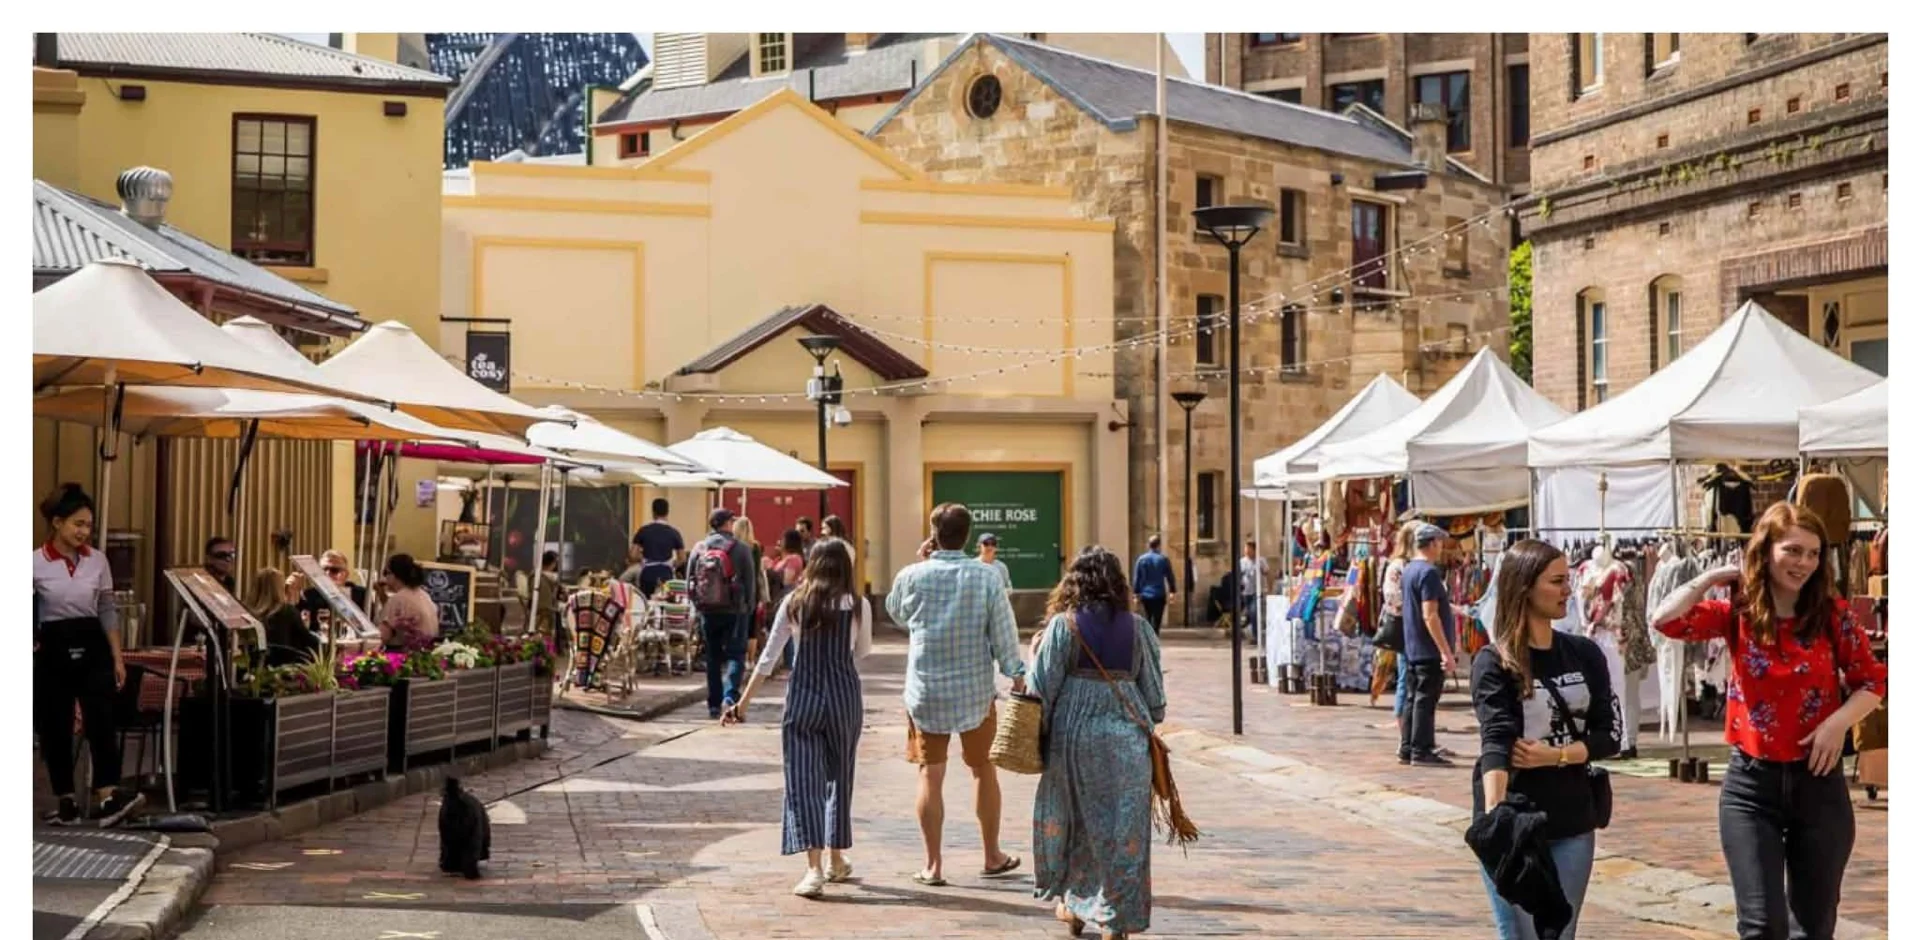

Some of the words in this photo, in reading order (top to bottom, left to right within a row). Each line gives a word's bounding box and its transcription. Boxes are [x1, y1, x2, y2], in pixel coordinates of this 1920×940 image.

[471, 360, 495, 370] tea
[471, 368, 505, 381] cosy
[971, 508, 1002, 522] CHIE
[1005, 508, 1038, 522] ROSE
